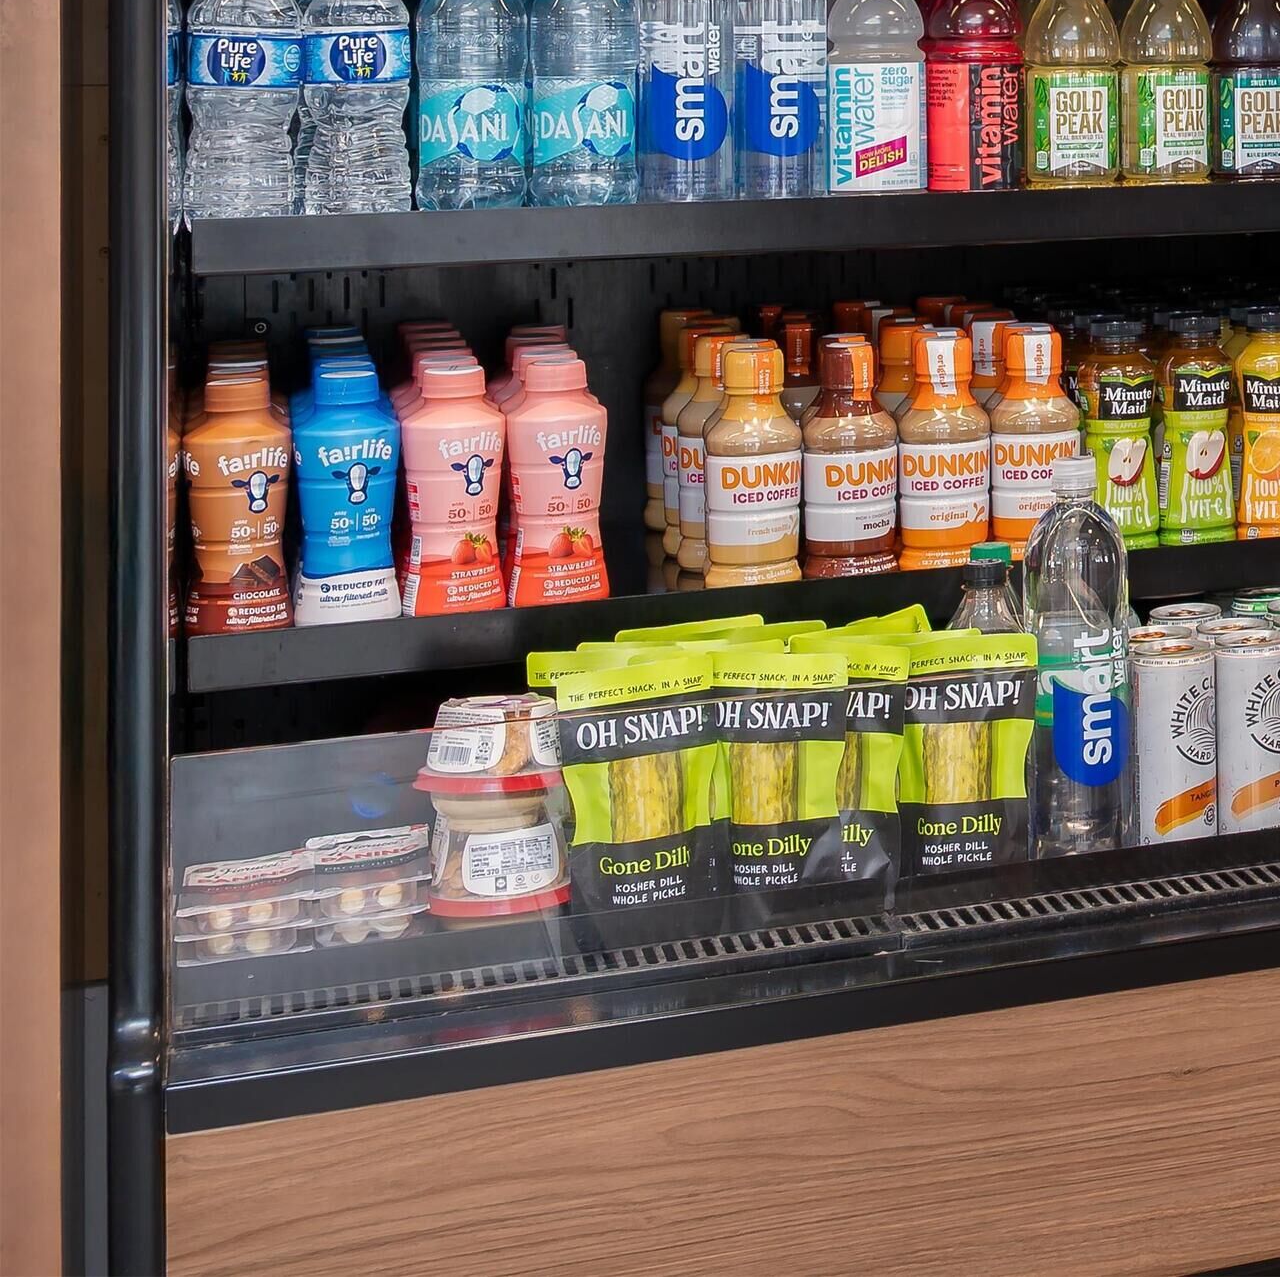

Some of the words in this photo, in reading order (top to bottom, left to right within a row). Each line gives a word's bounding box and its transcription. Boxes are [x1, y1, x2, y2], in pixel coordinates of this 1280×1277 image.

[217, 38, 257, 54] Pure
[338, 35, 378, 50] Pure
[220, 53, 255, 71] Life
[343, 49, 376, 67] Life
[880, 66, 907, 75] zero
[675, 21, 705, 142] smart
[881, 75, 914, 87] sugar
[853, 67, 875, 149] water
[1003, 67, 1018, 146] water
[1056, 90, 1103, 112] GOLD
[1162, 89, 1204, 113] GOLD
[421, 104, 508, 152] DASANI
[833, 66, 853, 186] vitamin
[975, 66, 1002, 185] vitamin
[1056, 113, 1103, 134] PEAK
[1163, 113, 1205, 132] PEAK
[859, 149, 904, 172] DELISH
[1104, 387, 1152, 403] Minute
[1179, 379, 1230, 394] Minute
[1111, 400, 1147, 415] Maid
[1186, 390, 1225, 407] Maid
[911, 480, 939, 492] ICED
[942, 475, 985, 490] COFFEE
[732, 491, 764, 505] ICED
[766, 487, 799, 502] COFFEE
[863, 518, 890, 532] mocha
[930, 510, 969, 522] original
[451, 565, 496, 579] STRAWBERRY
[548, 559, 596, 572] STRAWBERRY
[233, 588, 280, 599] CHOCOLATE
[332, 581, 373, 591] REDUCED
[375, 578, 386, 587] FAT
[904, 687, 936, 711] OH
[943, 681, 1024, 711] SNAP!
[1073, 629, 1114, 765] smart
[1245, 675, 1275, 727] WHITE
[576, 720, 616, 750] OH
[624, 706, 704, 742] SNAP!
[917, 817, 957, 836] Gone
[961, 813, 1003, 835] Dilly
[925, 842, 961, 854] KOSHER
[965, 841, 988, 851] DILL
[922, 854, 952, 866] WHOLE
[957, 852, 992, 863] PICKLE
[615, 881, 657, 893] KOSHER
[660, 875, 683, 886] DILL
[613, 894, 648, 905] WHOLE
[653, 886, 686, 902] PICKLE
